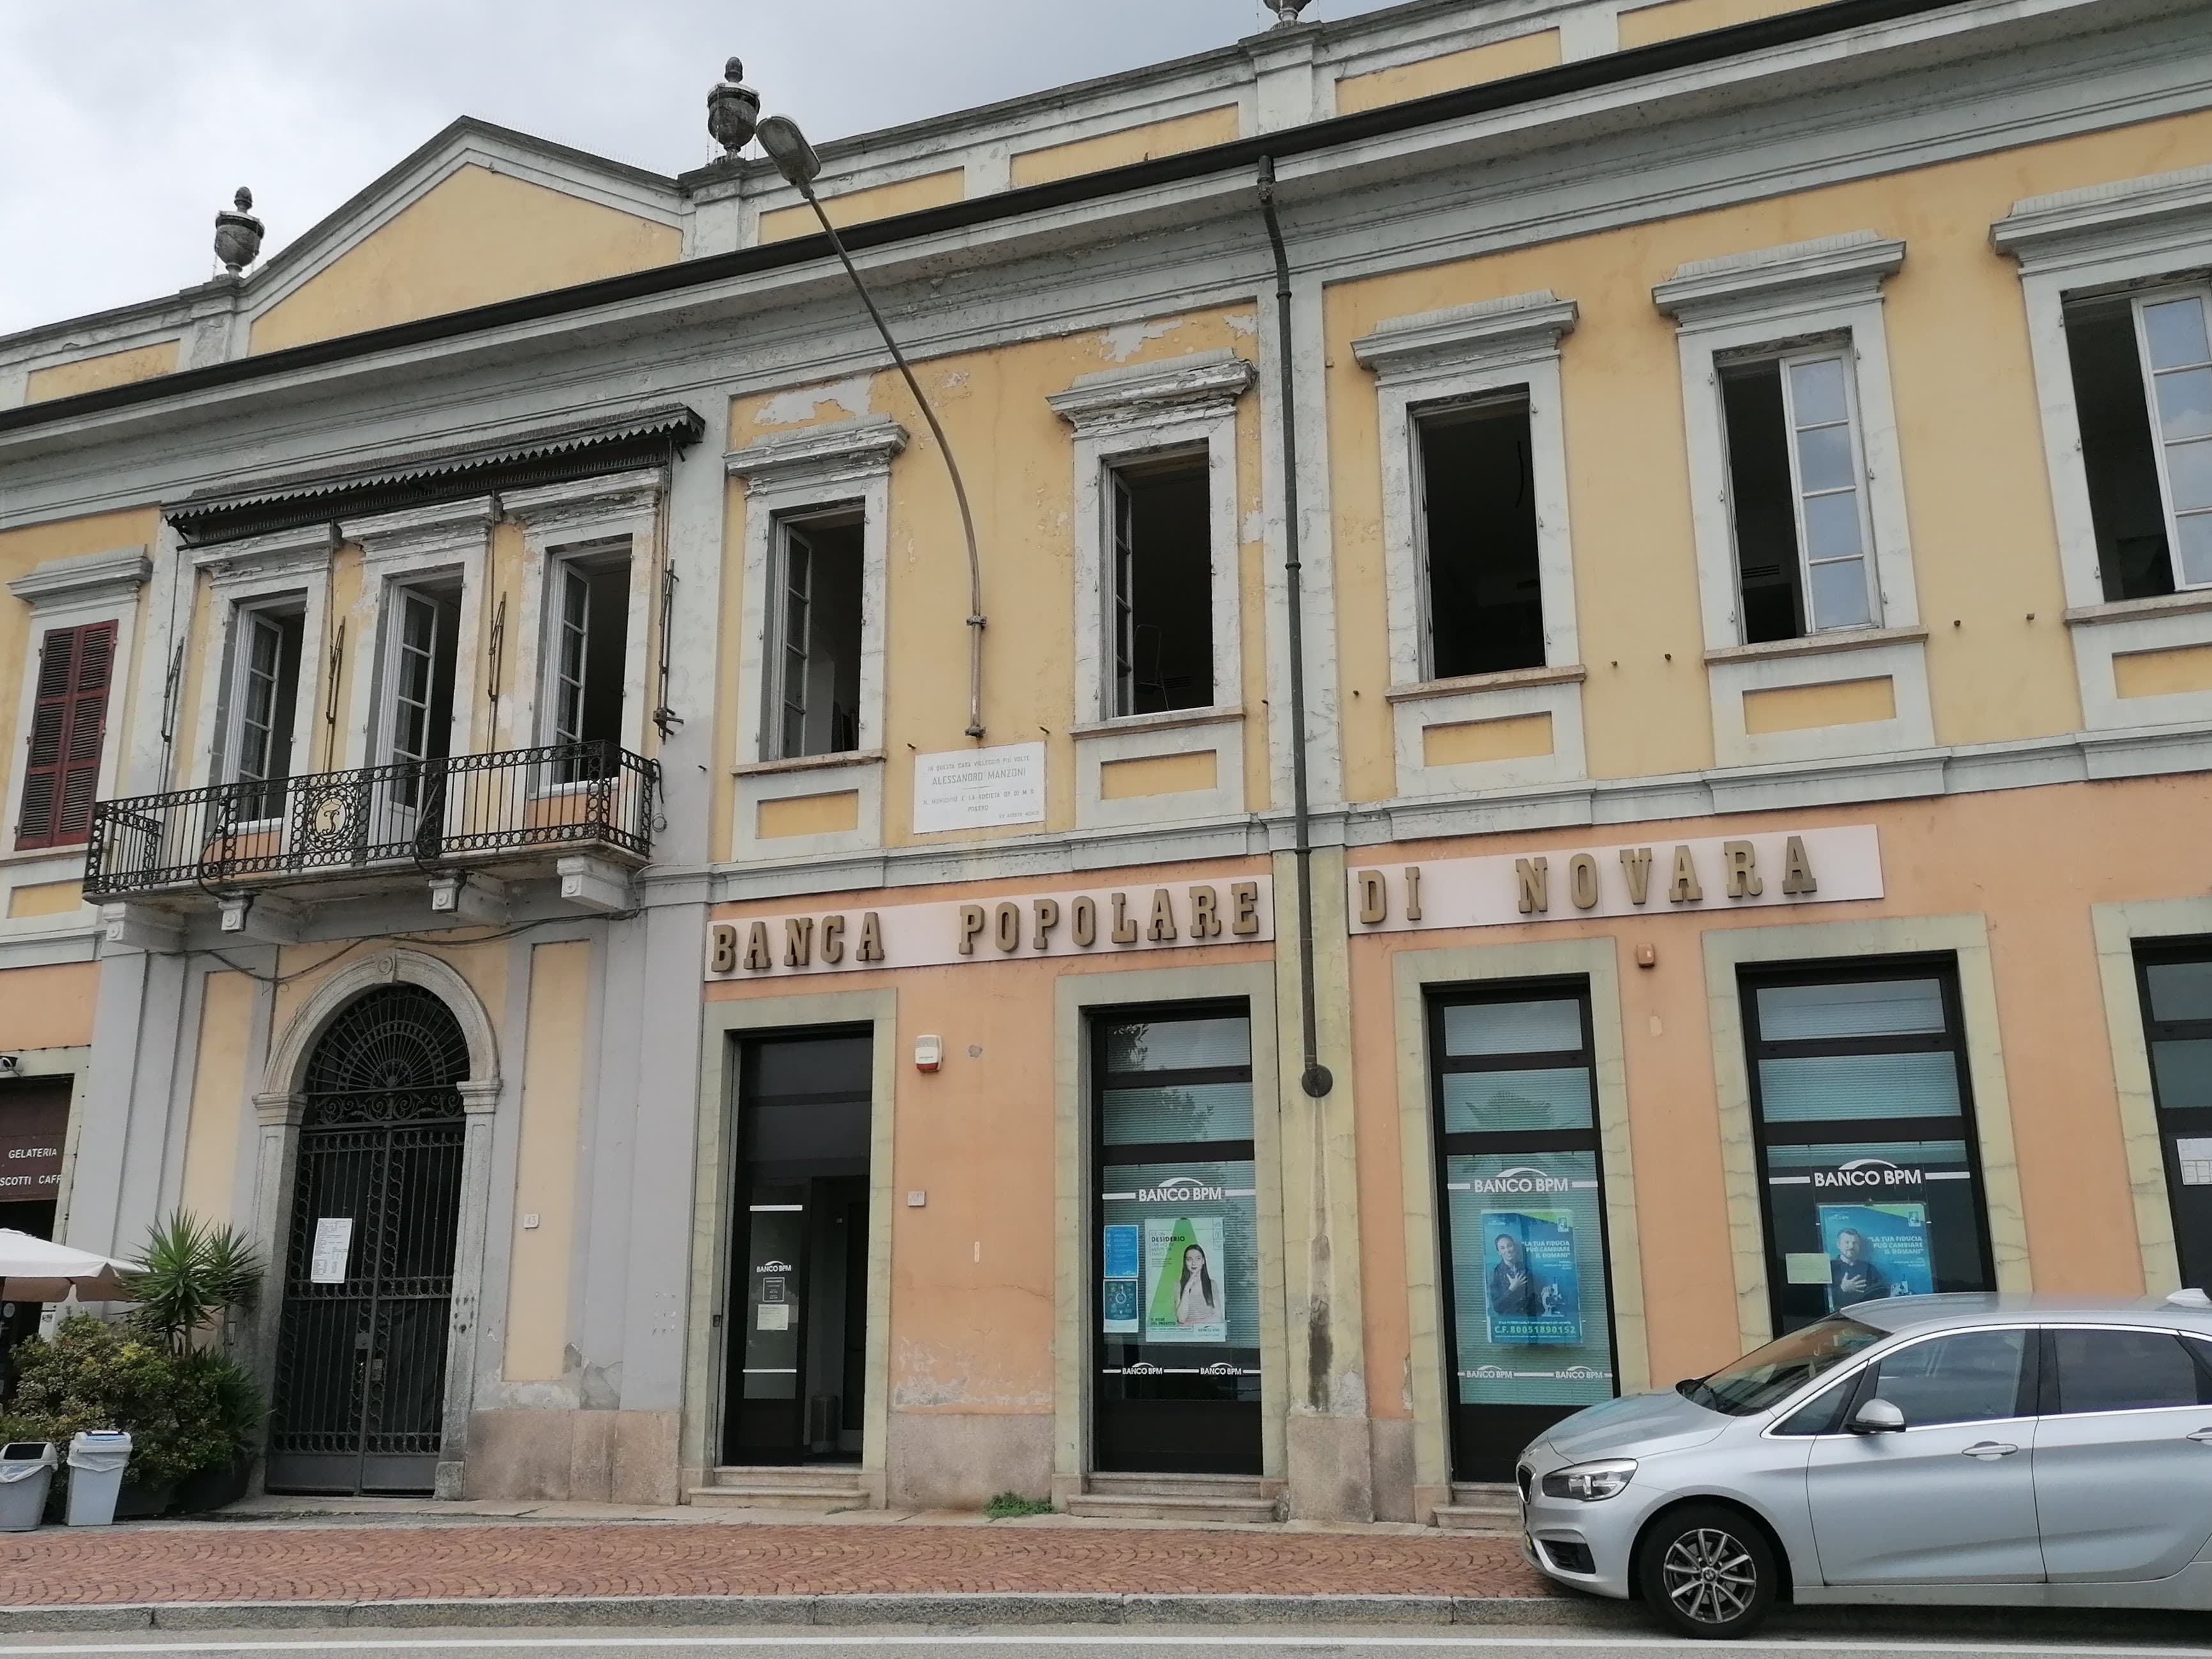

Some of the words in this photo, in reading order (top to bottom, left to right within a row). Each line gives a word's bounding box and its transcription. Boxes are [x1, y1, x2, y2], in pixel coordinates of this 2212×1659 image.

[932, 772, 983, 785] ALESSANDRO
[988, 767, 1026, 780] MANZONI
[1358, 866, 1422, 924] DI
[1516, 836, 1818, 914] NOVARA
[711, 912, 885, 972] BANCA
[958, 881, 1259, 955] POPOLARE
[8, 1148, 57, 1159] GELATERIA
[1474, 1179, 1532, 1193] BANCO
[1536, 1178, 1568, 1192] BPM
[1814, 1170, 1880, 1187] BANCO
[1884, 1169, 1921, 1185] BPM
[1139, 1188, 1190, 1202] BANCO
[1193, 1187, 1222, 1200] BPM
[1510, 1326, 1576, 1334] 80051890152
